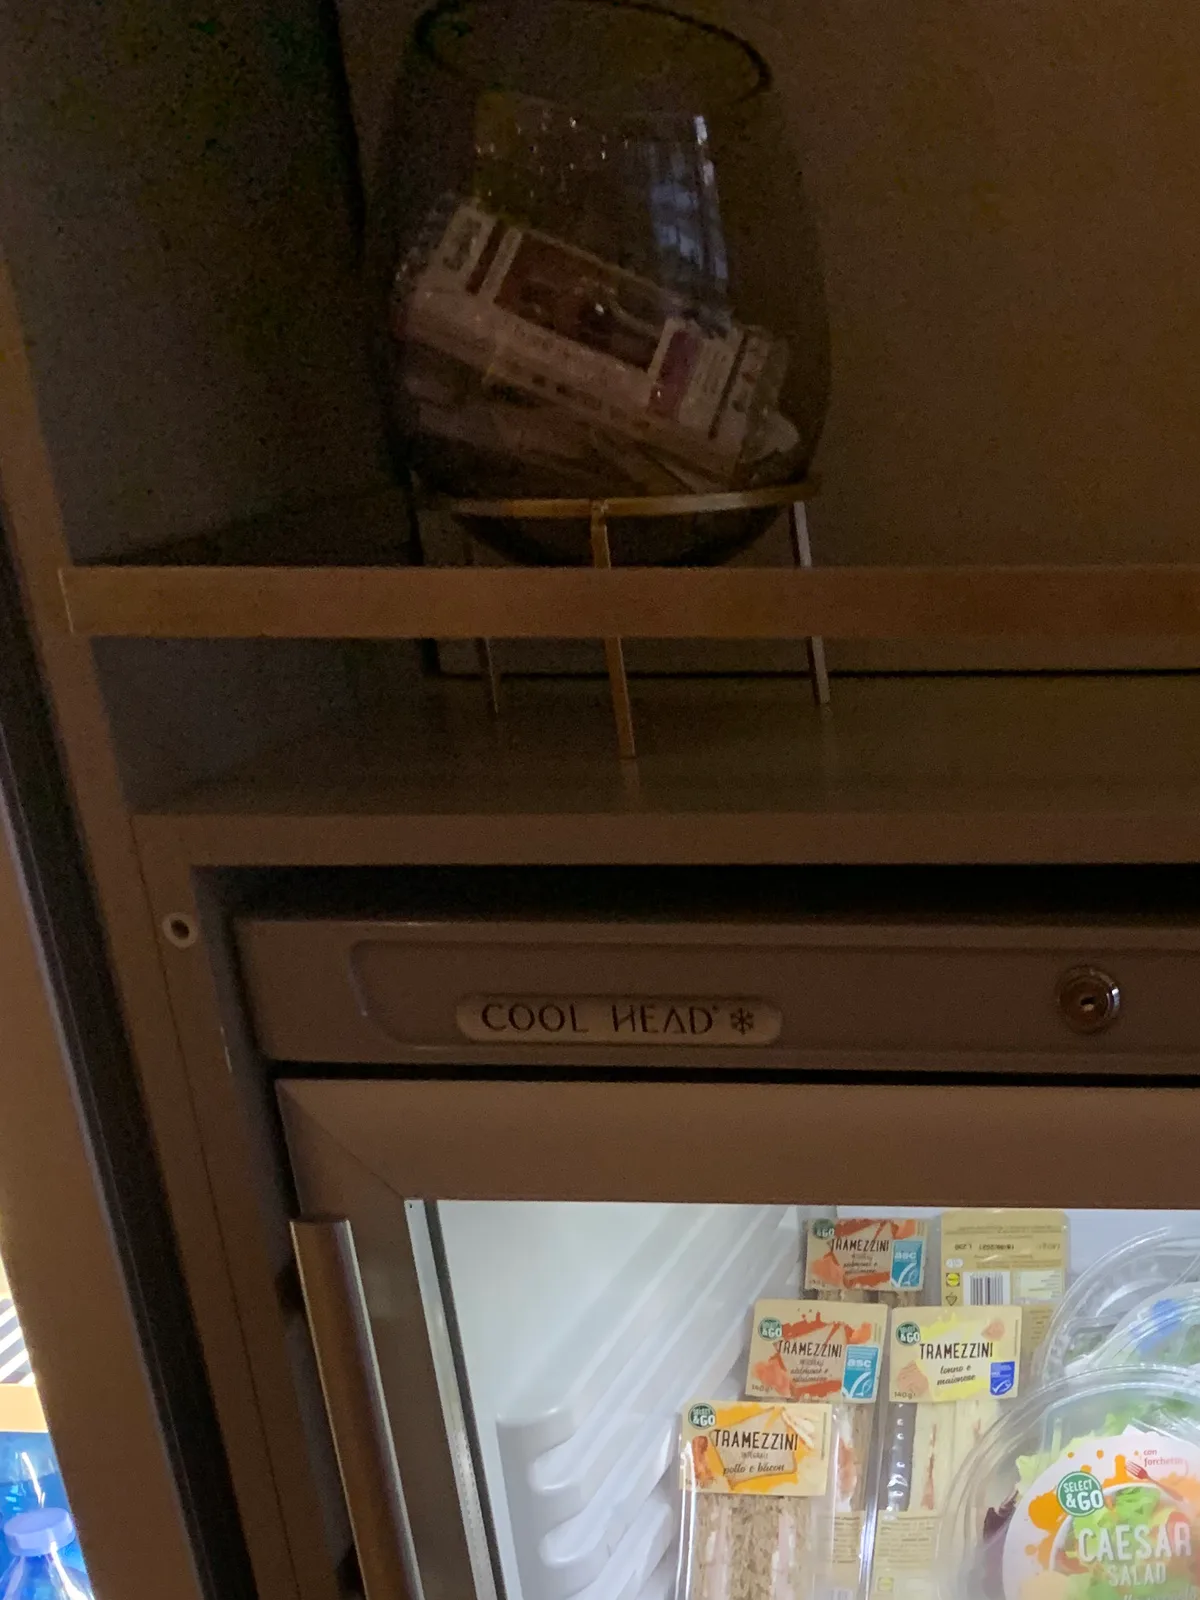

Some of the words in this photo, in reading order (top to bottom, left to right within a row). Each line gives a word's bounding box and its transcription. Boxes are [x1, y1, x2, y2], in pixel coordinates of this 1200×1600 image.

[481, 1003, 589, 1032] COOL
[611, 1004, 713, 1034] HEAD
[831, 1239, 890, 1252] TRAMEZZINI
[778, 1340, 842, 1358] TRAMEZZINI
[920, 1342, 993, 1360] TRAMEZZINI
[847, 1359, 872, 1368] asc
[692, 1415, 715, 1426] &GO
[713, 1429, 798, 1451] TRAMEZZINI
[723, 1463, 745, 1476] pollo
[757, 1462, 785, 1473] bacon
[1063, 1479, 1093, 1493] SELECT
[1066, 1490, 1103, 1511] &GO
[1078, 1522, 1192, 1562] CAESAR
[1108, 1562, 1167, 1587] SALAD
